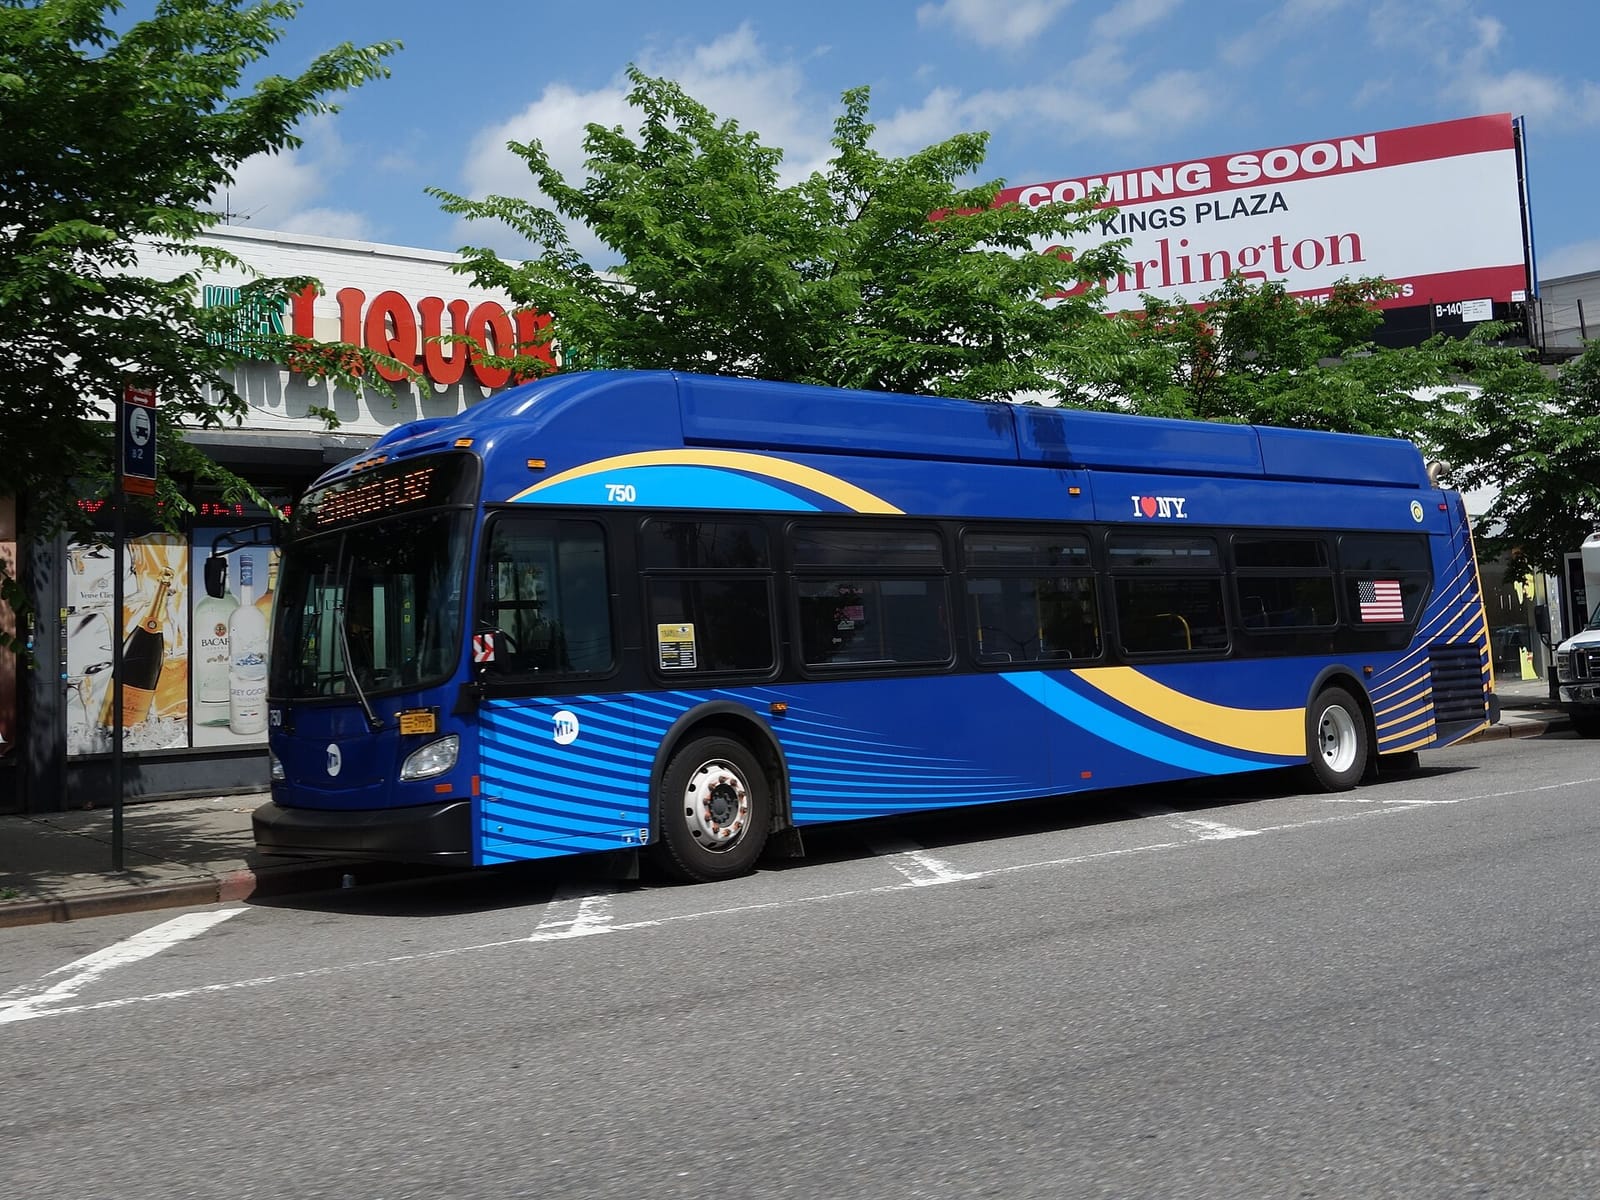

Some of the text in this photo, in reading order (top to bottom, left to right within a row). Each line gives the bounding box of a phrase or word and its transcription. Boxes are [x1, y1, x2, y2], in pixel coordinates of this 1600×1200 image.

[1018, 135, 1377, 210] COMING SOON
[1100, 190, 1289, 237] KINGS PLAZA
[1435, 302, 1463, 318] B-140
[604, 483, 637, 503] 750
